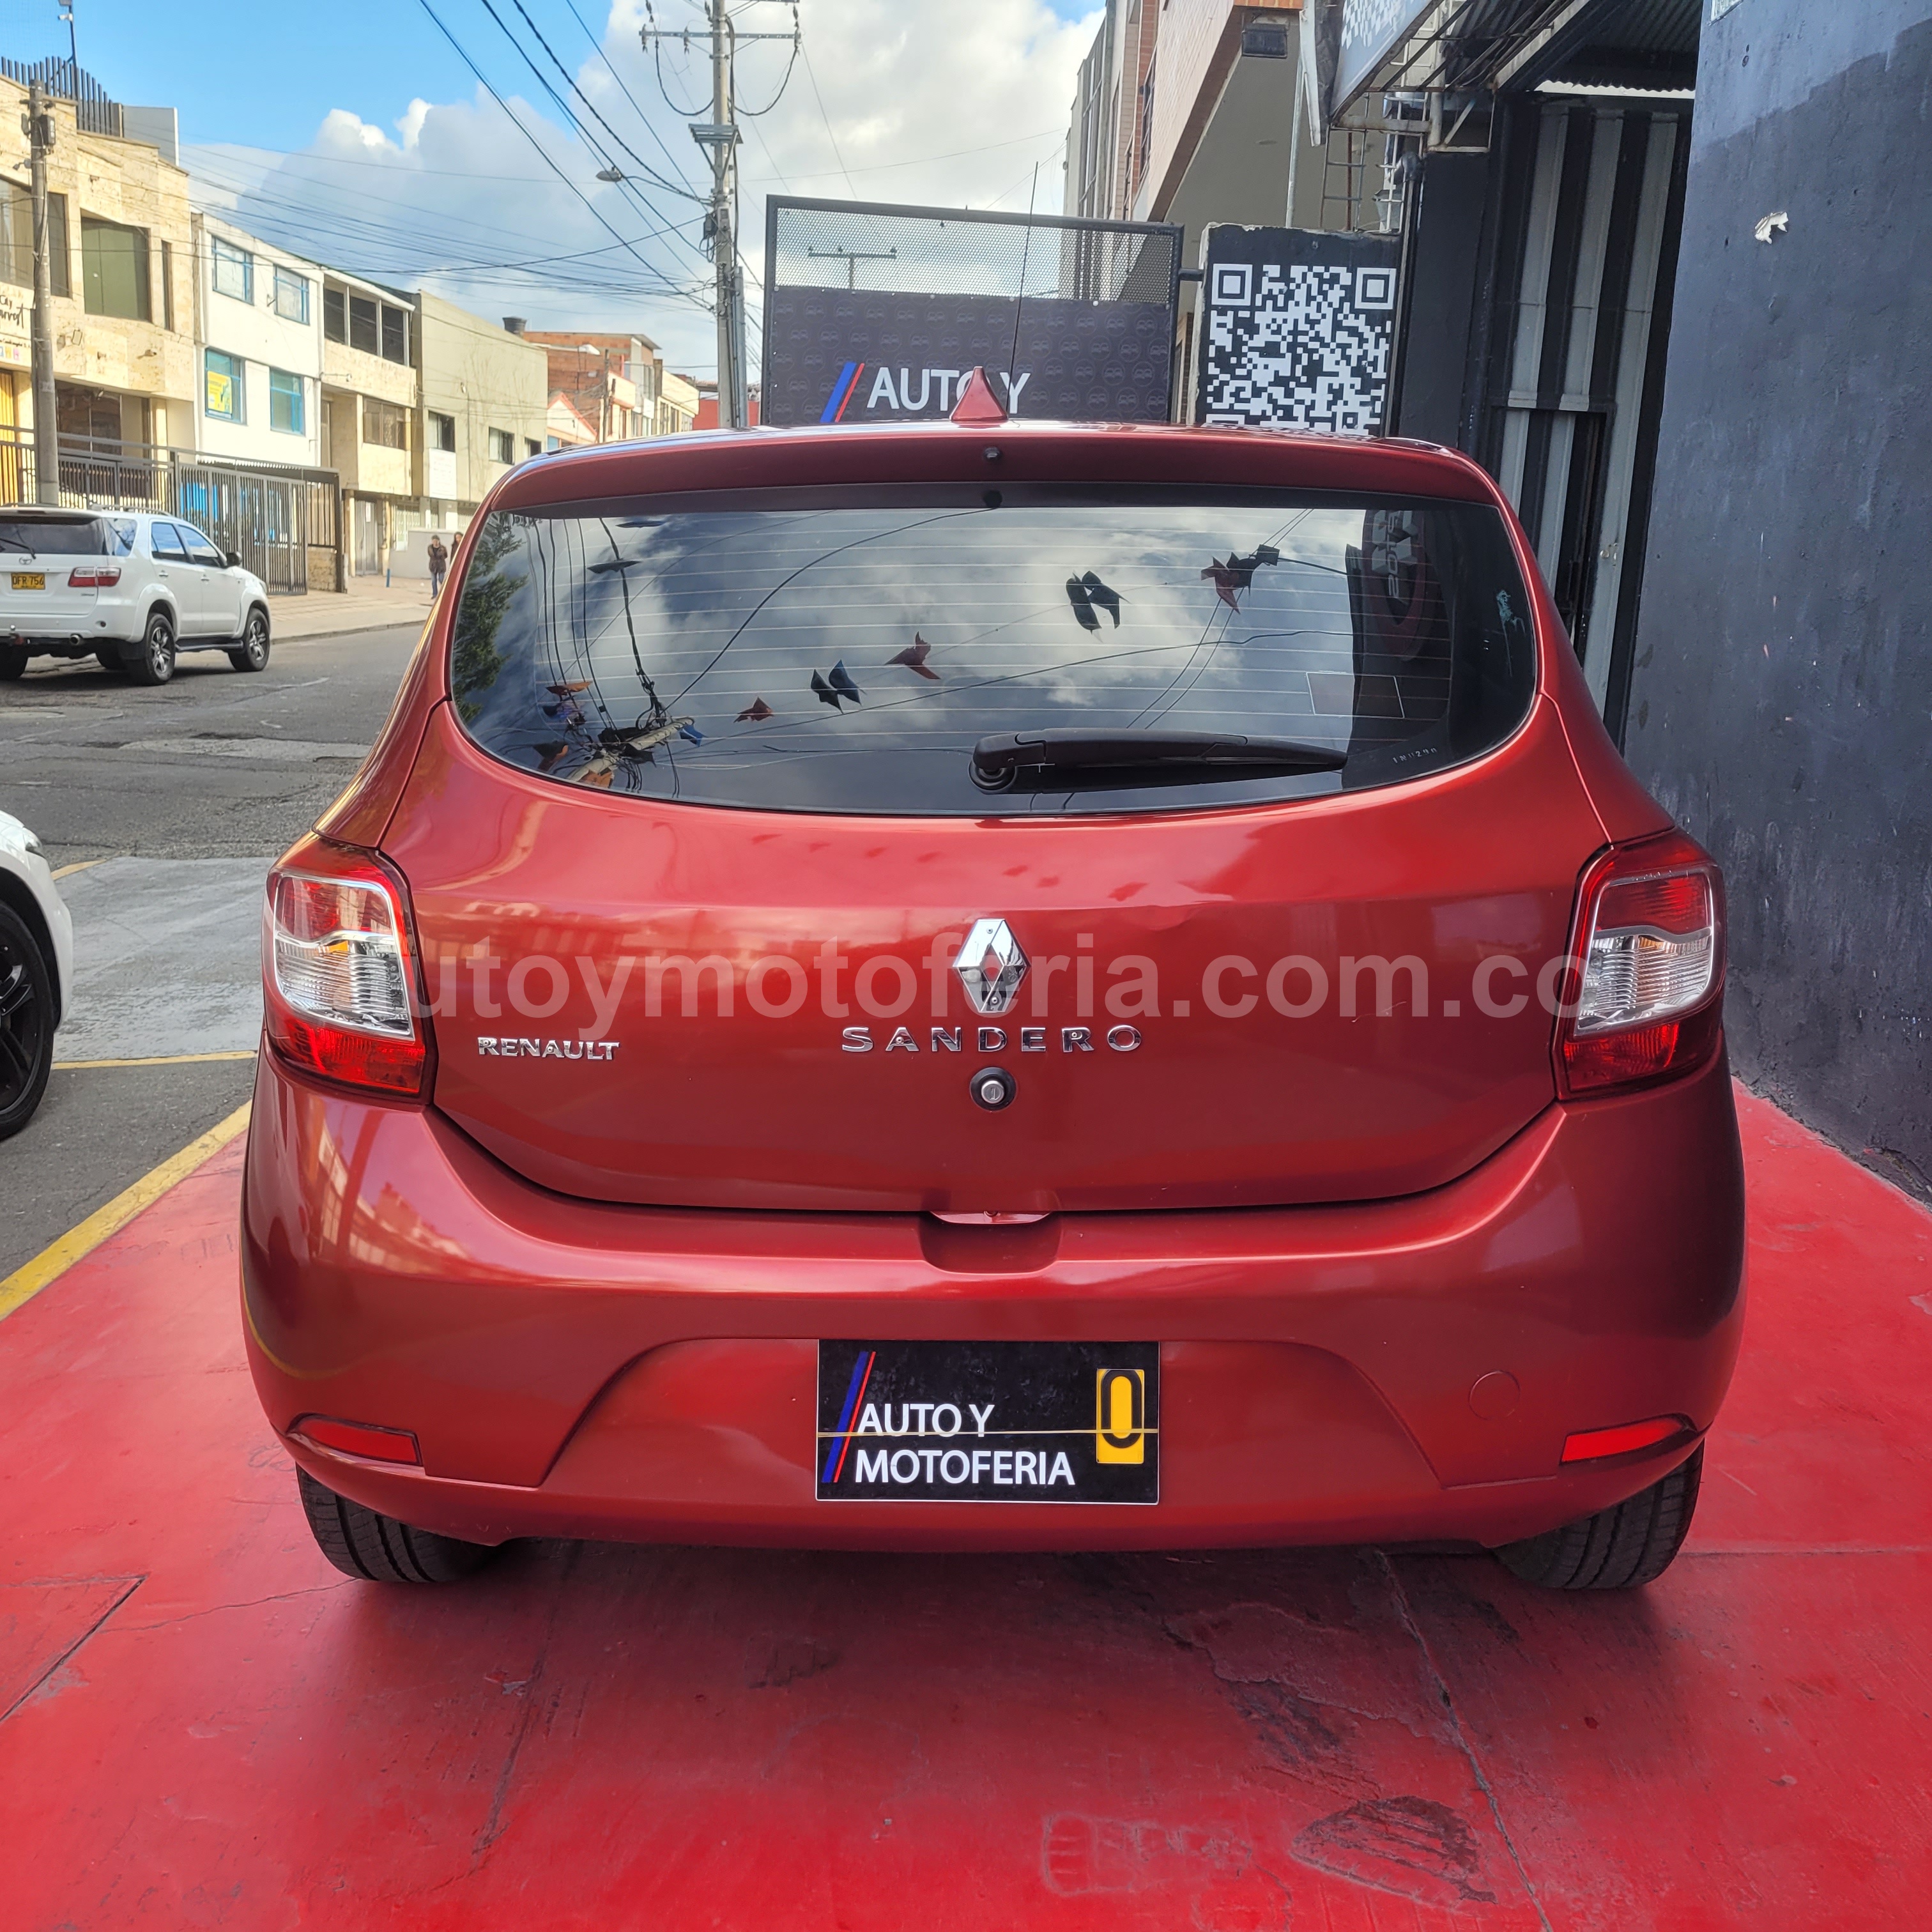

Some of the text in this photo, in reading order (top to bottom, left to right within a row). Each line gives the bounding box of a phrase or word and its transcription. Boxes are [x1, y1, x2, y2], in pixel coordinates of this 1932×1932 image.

[999, 372, 1031, 414] Y
[477, 1036, 620, 1061] RENAULT
[841, 1024, 1142, 1053] SANDERO
[857, 1403, 995, 1438] AUTO Y
[855, 1449, 1076, 1485] MOTOFERIA
